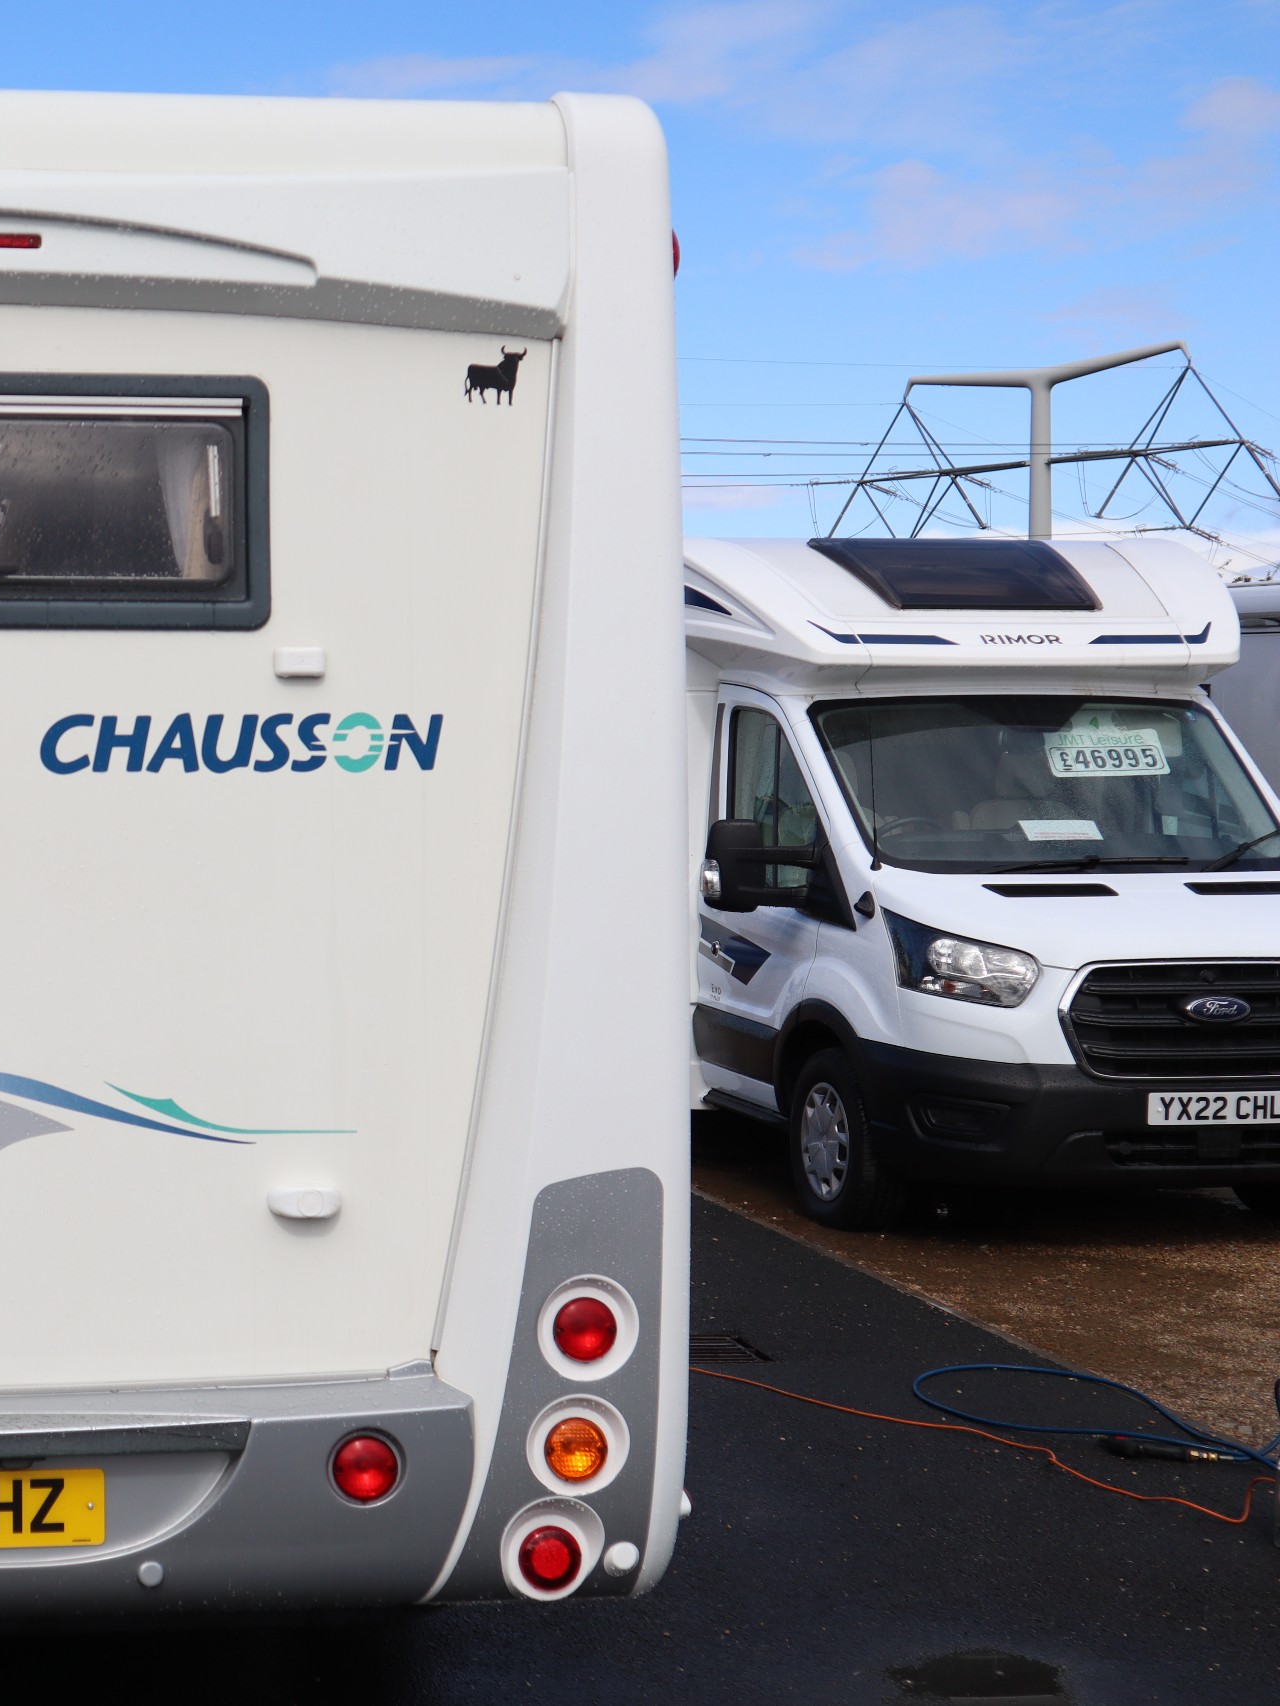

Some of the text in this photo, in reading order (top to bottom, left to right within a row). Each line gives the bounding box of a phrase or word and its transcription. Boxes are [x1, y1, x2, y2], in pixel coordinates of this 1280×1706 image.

[980, 634, 1063, 645] RIMOR
[39, 711, 443, 775] CHAUSSON
[1090, 734, 1144, 746] Leisure
[1060, 748, 1158, 770] £46995
[1203, 1000, 1238, 1015] Ford
[1160, 1095, 1280, 1120] YX22 CHL
